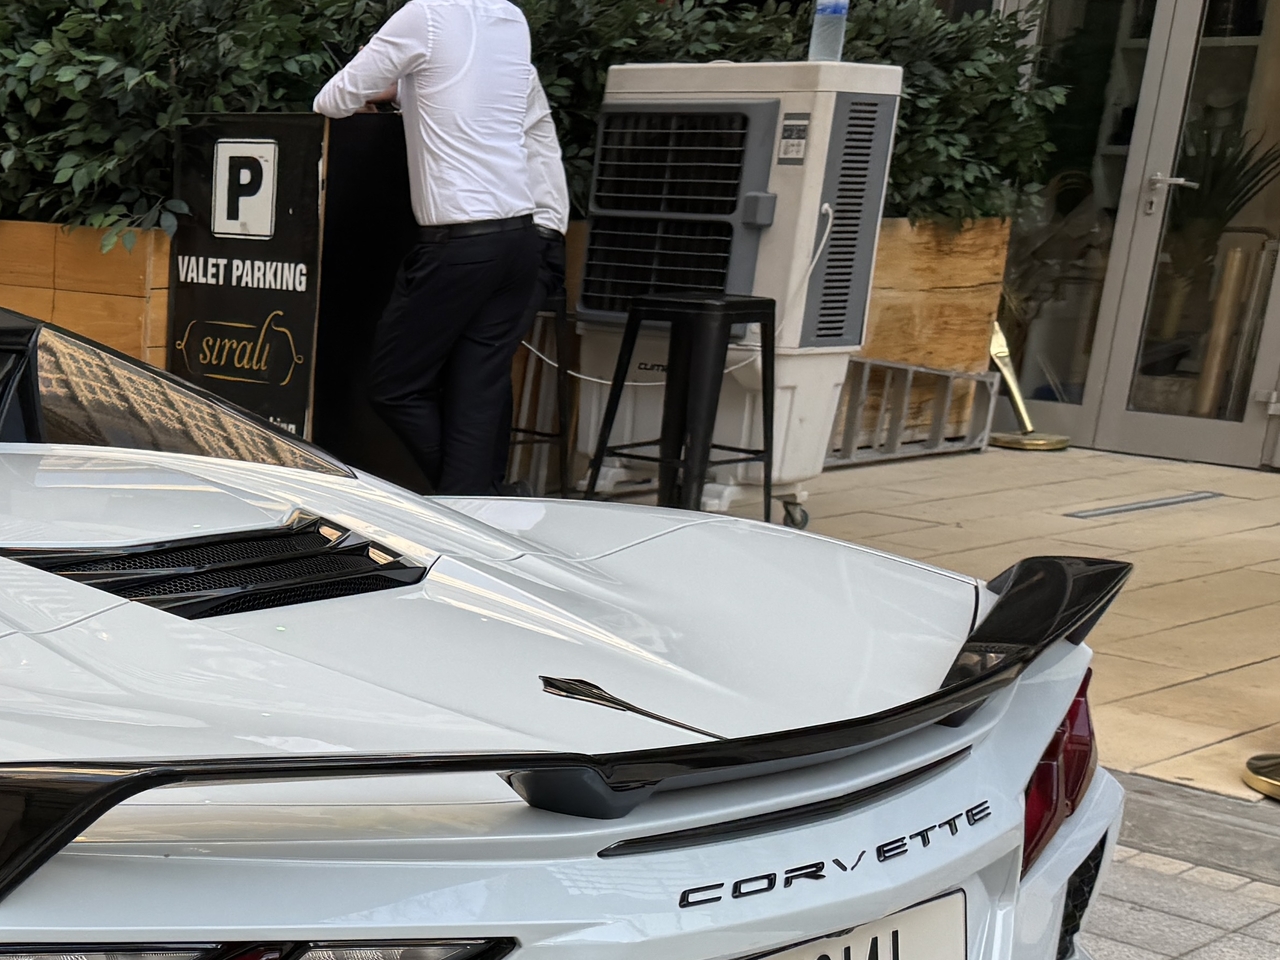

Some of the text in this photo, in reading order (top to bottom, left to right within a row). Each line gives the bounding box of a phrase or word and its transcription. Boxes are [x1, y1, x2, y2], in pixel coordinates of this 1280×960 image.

[227, 155, 264, 221] P
[177, 255, 308, 293] VALET PARKING
[678, 799, 993, 909] CORVETTE
